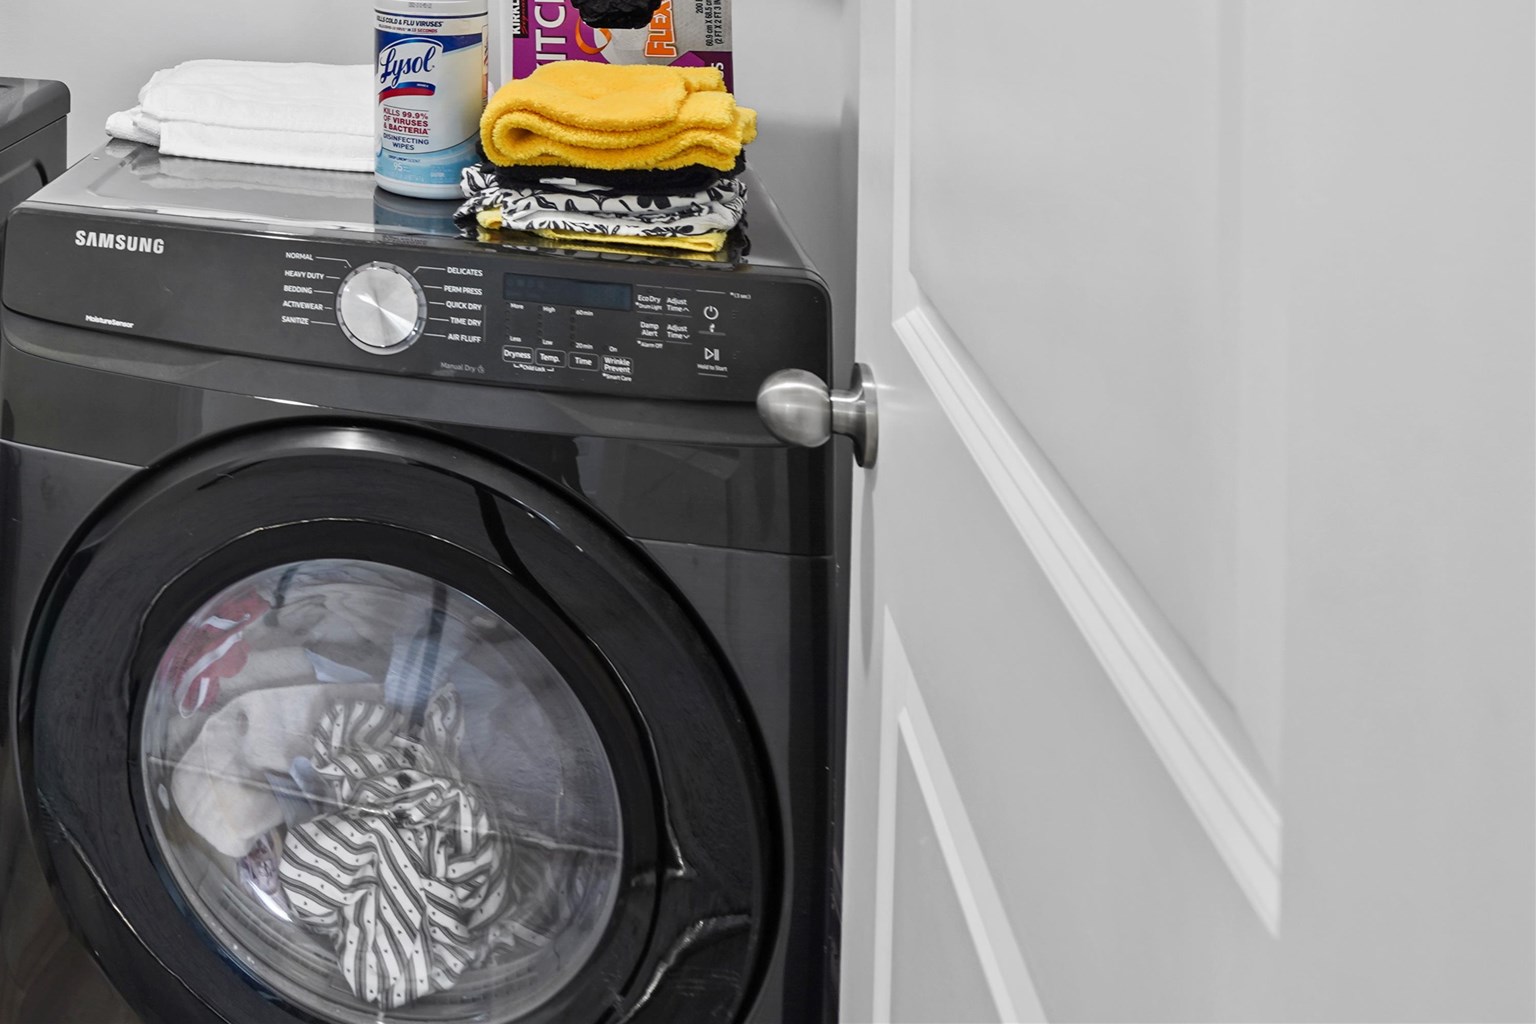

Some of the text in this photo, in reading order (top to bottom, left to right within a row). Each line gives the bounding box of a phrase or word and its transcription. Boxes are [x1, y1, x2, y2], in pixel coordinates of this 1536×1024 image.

[695, 3, 703, 14] 200
[704, 6, 712, 19] 68.5
[385, 17, 399, 25] COLD
[415, 20, 443, 28] VIRUSES
[706, 24, 713, 34] cm
[705, 34, 713, 47] 60.9
[380, 45, 436, 86] Lysol
[383, 107, 429, 120] KILLS 99.9%
[383, 114, 429, 128] OF VIRUSES
[389, 123, 429, 135] BACTERIA
[383, 132, 430, 146] DISINFECTING
[392, 142, 415, 151] WIPES
[75, 230, 165, 255] SAMSUNG
[285, 252, 314, 261] NORMAL
[284, 270, 325, 280] HEAVY DUTY
[446, 266, 484, 277] DELICATES
[283, 284, 313, 295] BEDDING
[443, 284, 483, 296] PERM PRESS
[282, 300, 324, 311] ACTIVEWEAR
[445, 300, 483, 311] QUICK DRY
[666, 297, 687, 306] Adjust
[542, 305, 556, 314] High
[666, 304, 683, 312] Time
[281, 315, 310, 325] SANITIZE
[449, 316, 482, 327] TIME DRY
[640, 320, 660, 330] Damp
[641, 329, 658, 337] Alert
[666, 324, 688, 333] Adjust
[447, 333, 482, 343] AIR FLUFF
[666, 331, 683, 340] Time
[504, 348, 532, 360] Dryness
[608, 345, 618, 353] On
[574, 356, 592, 366] Time
[604, 356, 631, 367] Wrinkle
[440, 362, 476, 374] Manual Dry
[604, 364, 631, 374] Prevent
